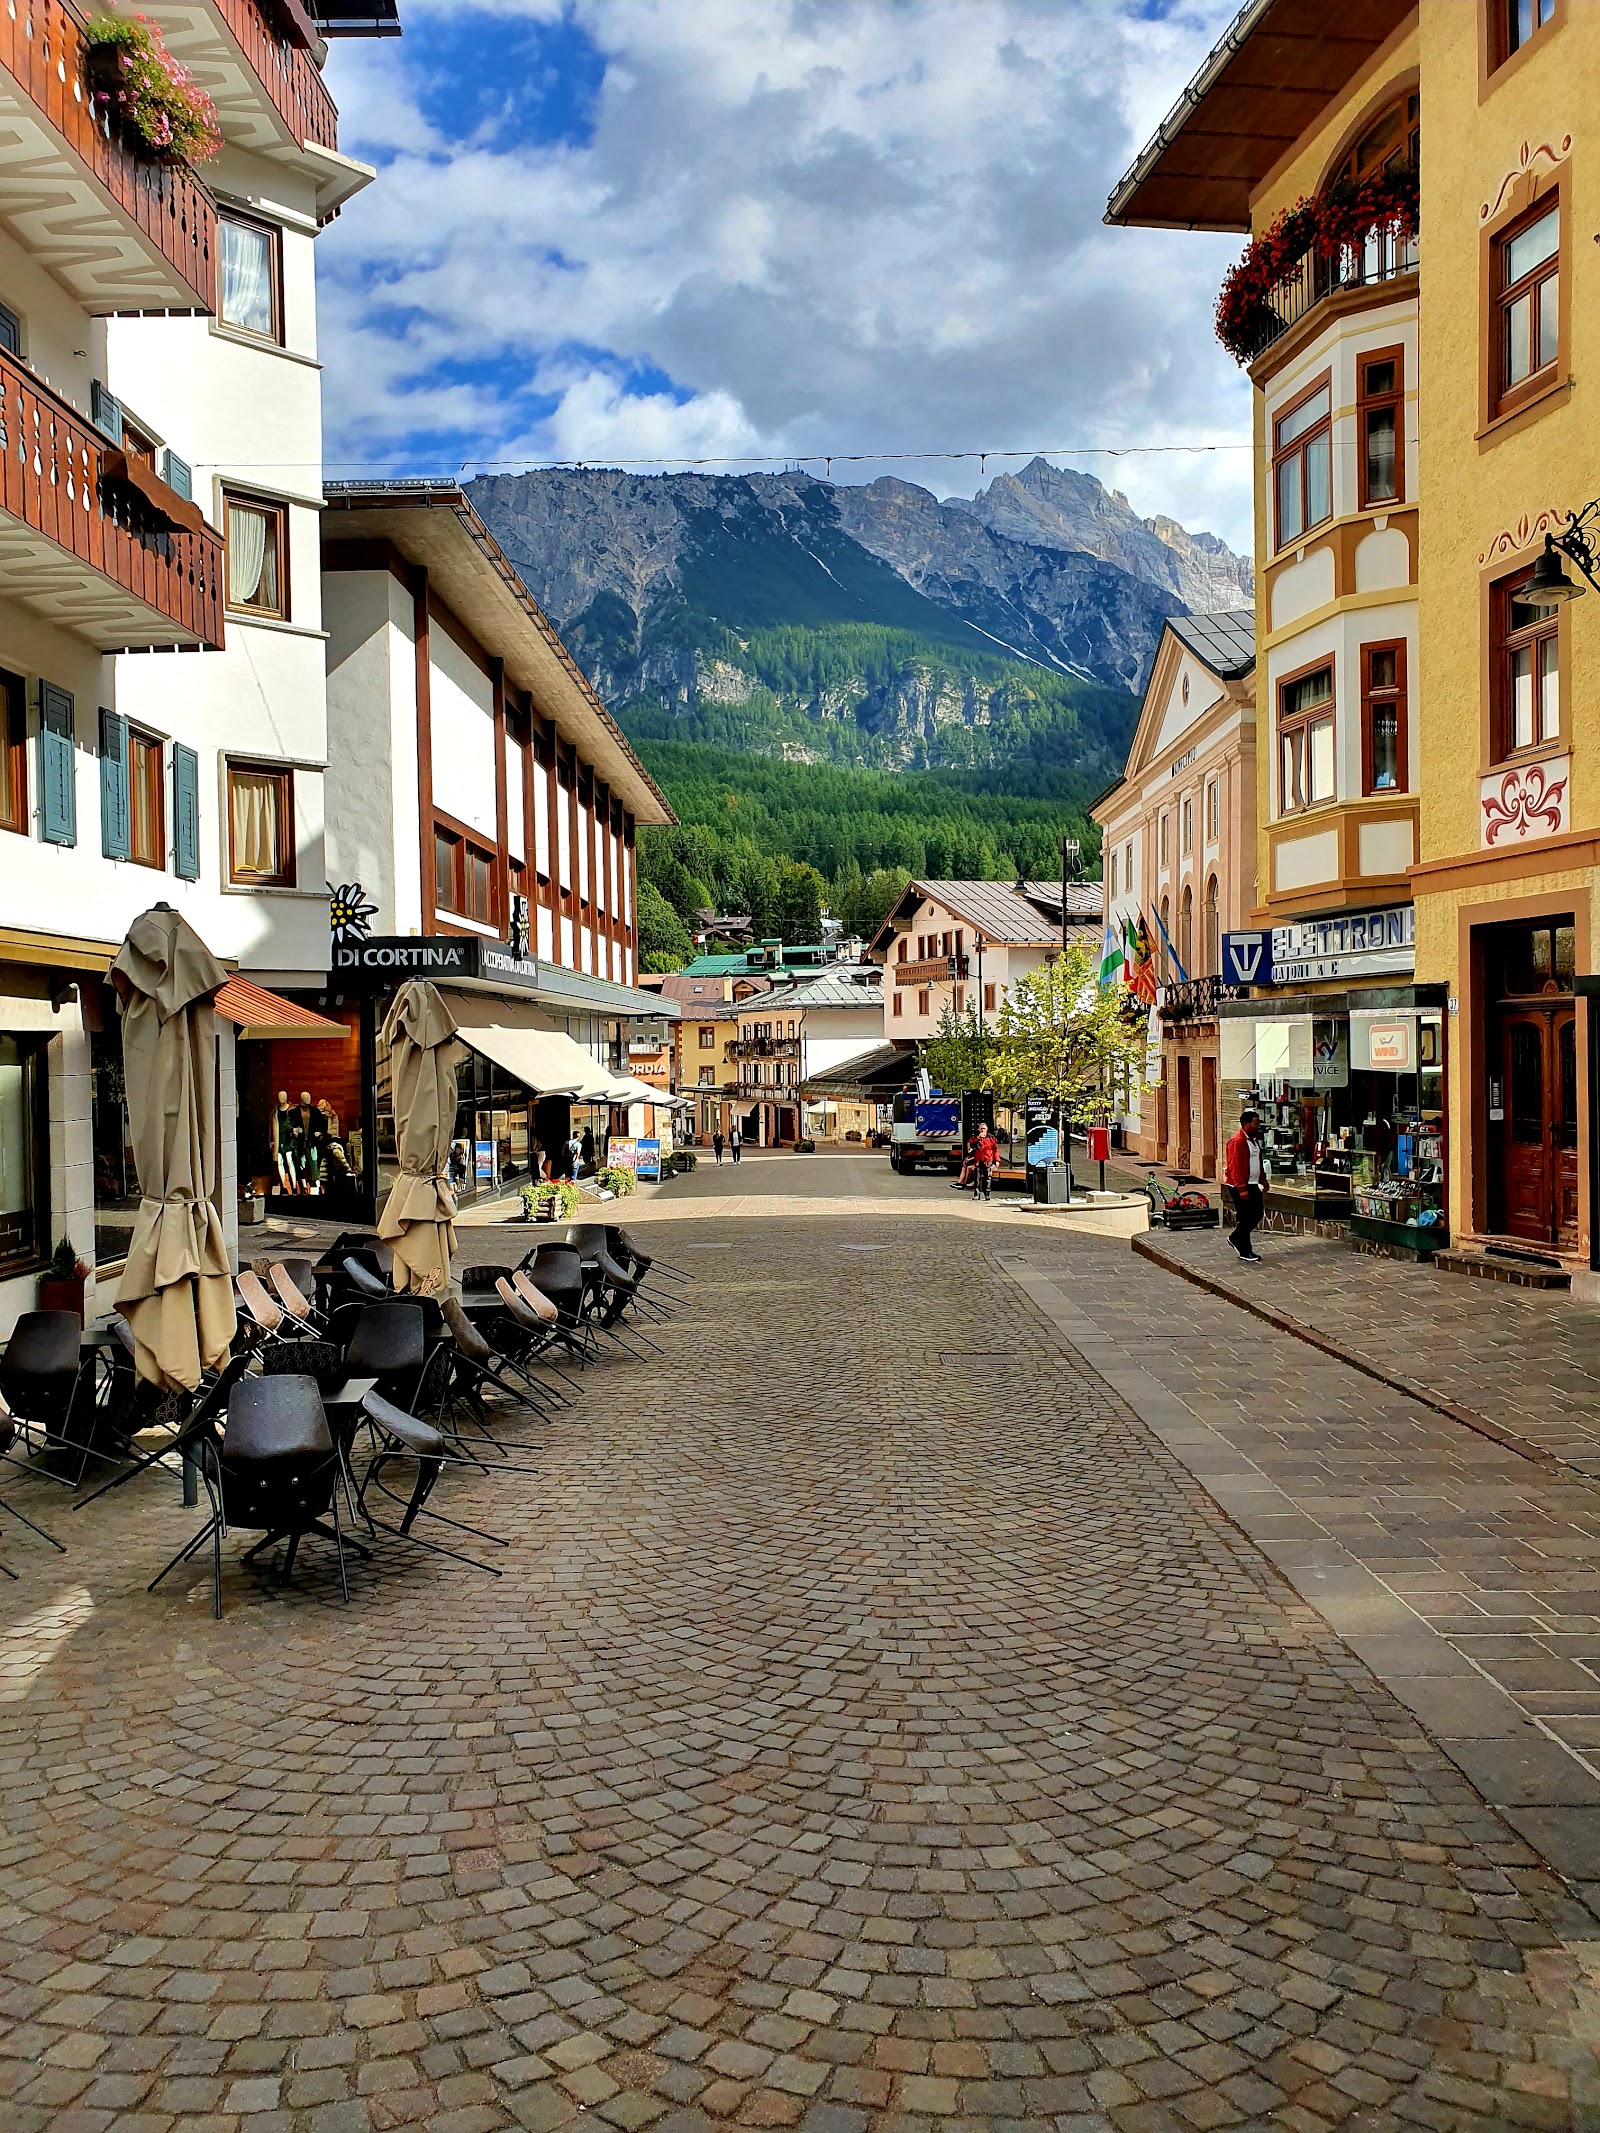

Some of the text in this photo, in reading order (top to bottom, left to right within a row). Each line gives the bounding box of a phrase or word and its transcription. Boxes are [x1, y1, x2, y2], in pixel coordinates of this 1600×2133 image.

[338, 949, 359, 966] DI
[1374, 1046, 1399, 1057] WIND
[1298, 1066, 1339, 1075] SERVICE
